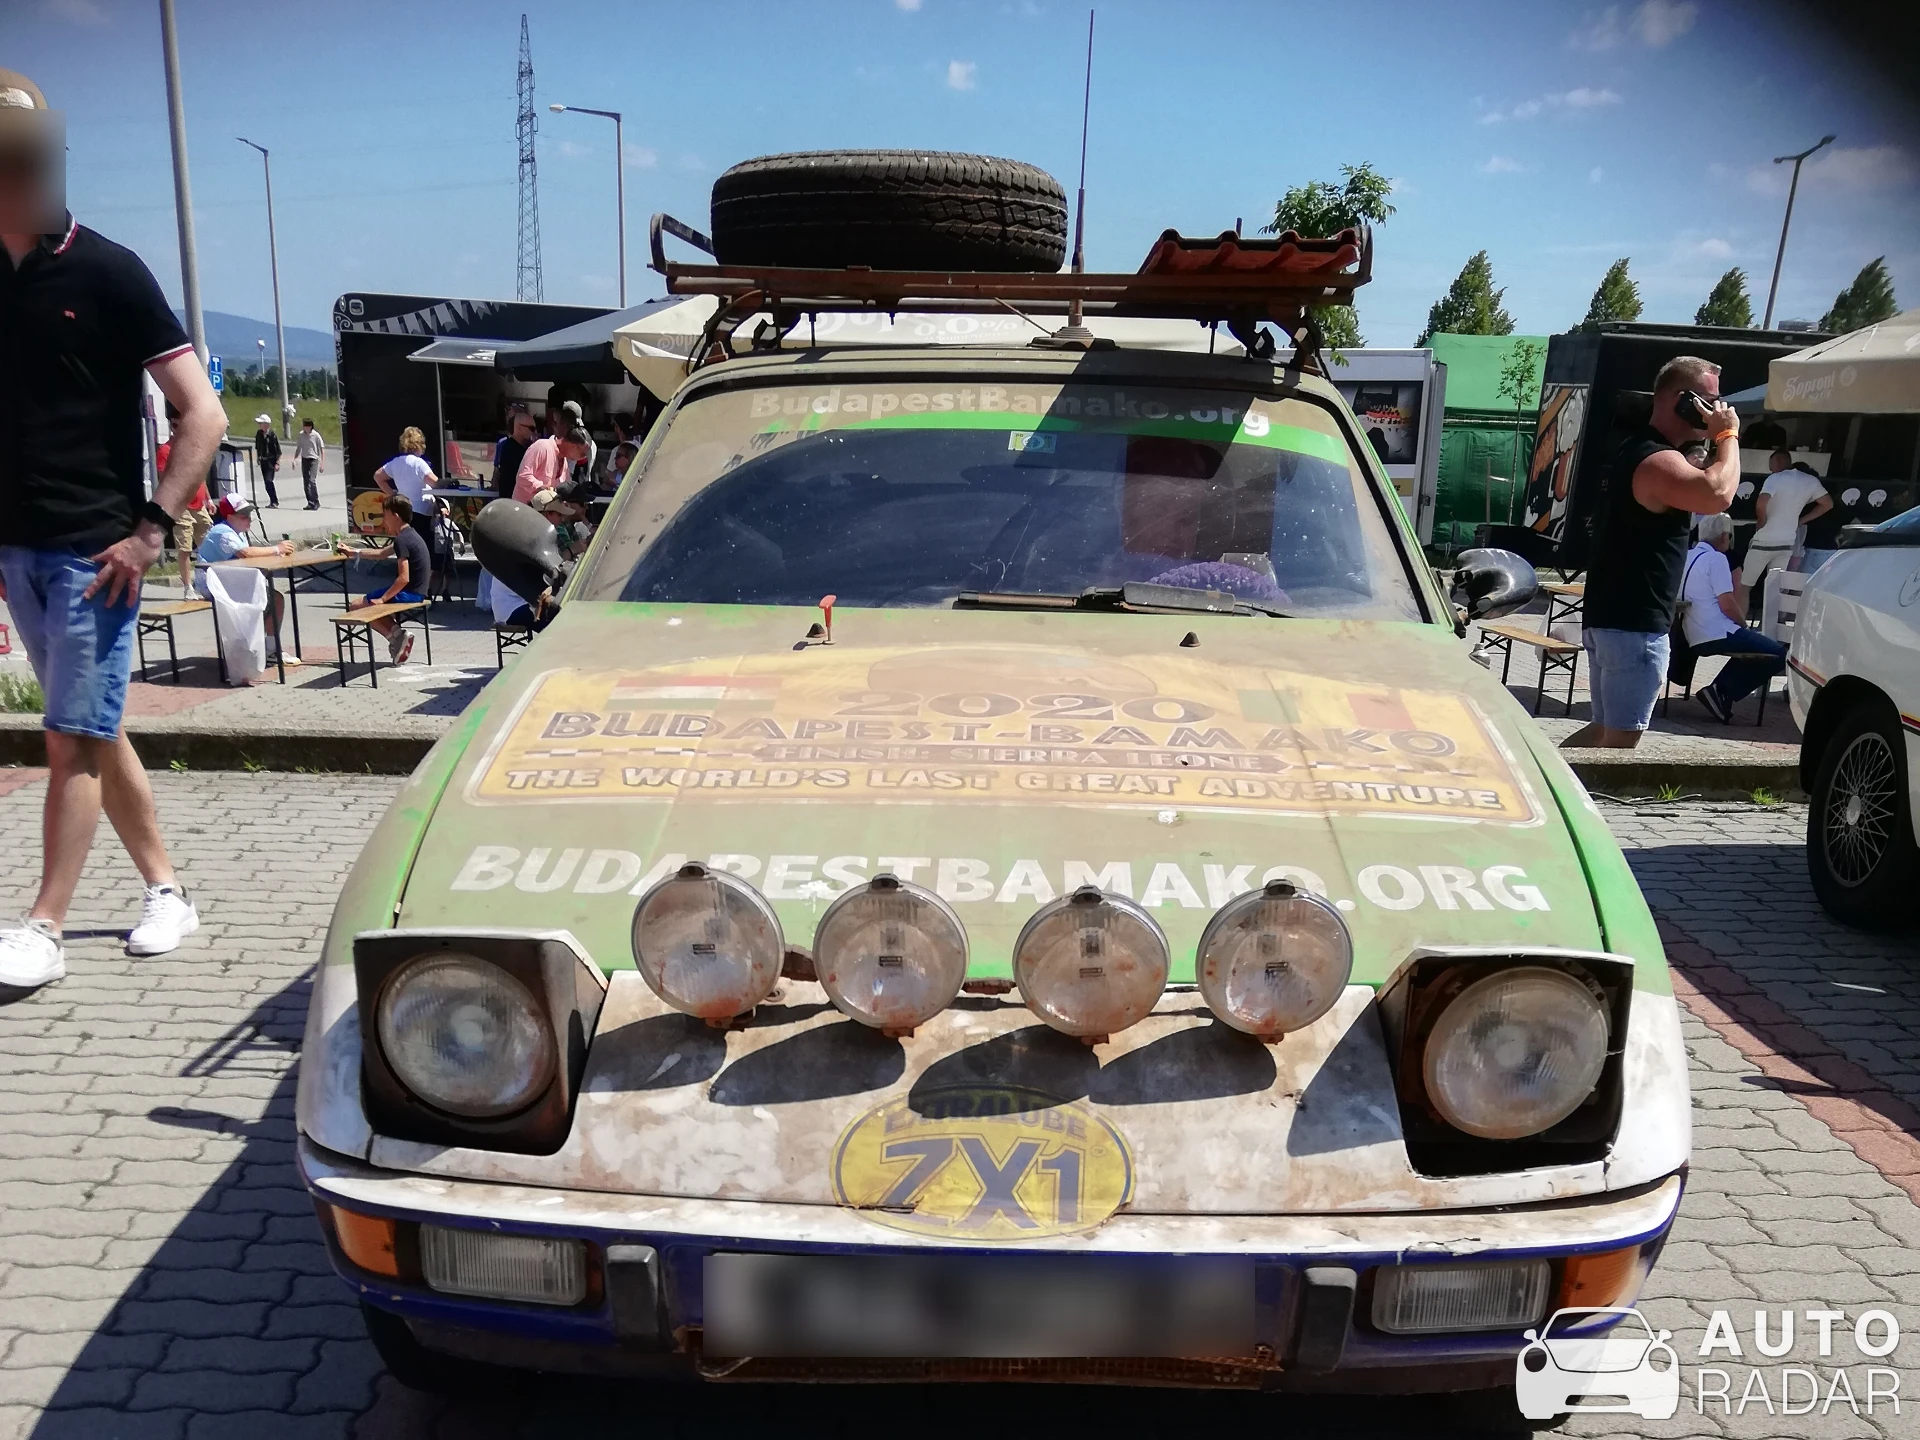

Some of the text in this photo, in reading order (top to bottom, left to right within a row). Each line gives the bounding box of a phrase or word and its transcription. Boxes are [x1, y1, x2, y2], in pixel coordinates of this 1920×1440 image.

[750, 386, 1269, 437] BudapestBamako.org
[833, 693, 1215, 724] 2020
[948, 747, 1109, 766] SIERRA
[1126, 751, 1263, 771] LEONE
[505, 769, 602, 790] THE
[865, 769, 998, 792] LAST
[1014, 770, 1181, 795] GREAT
[1200, 776, 1505, 810] ADVENTURE
